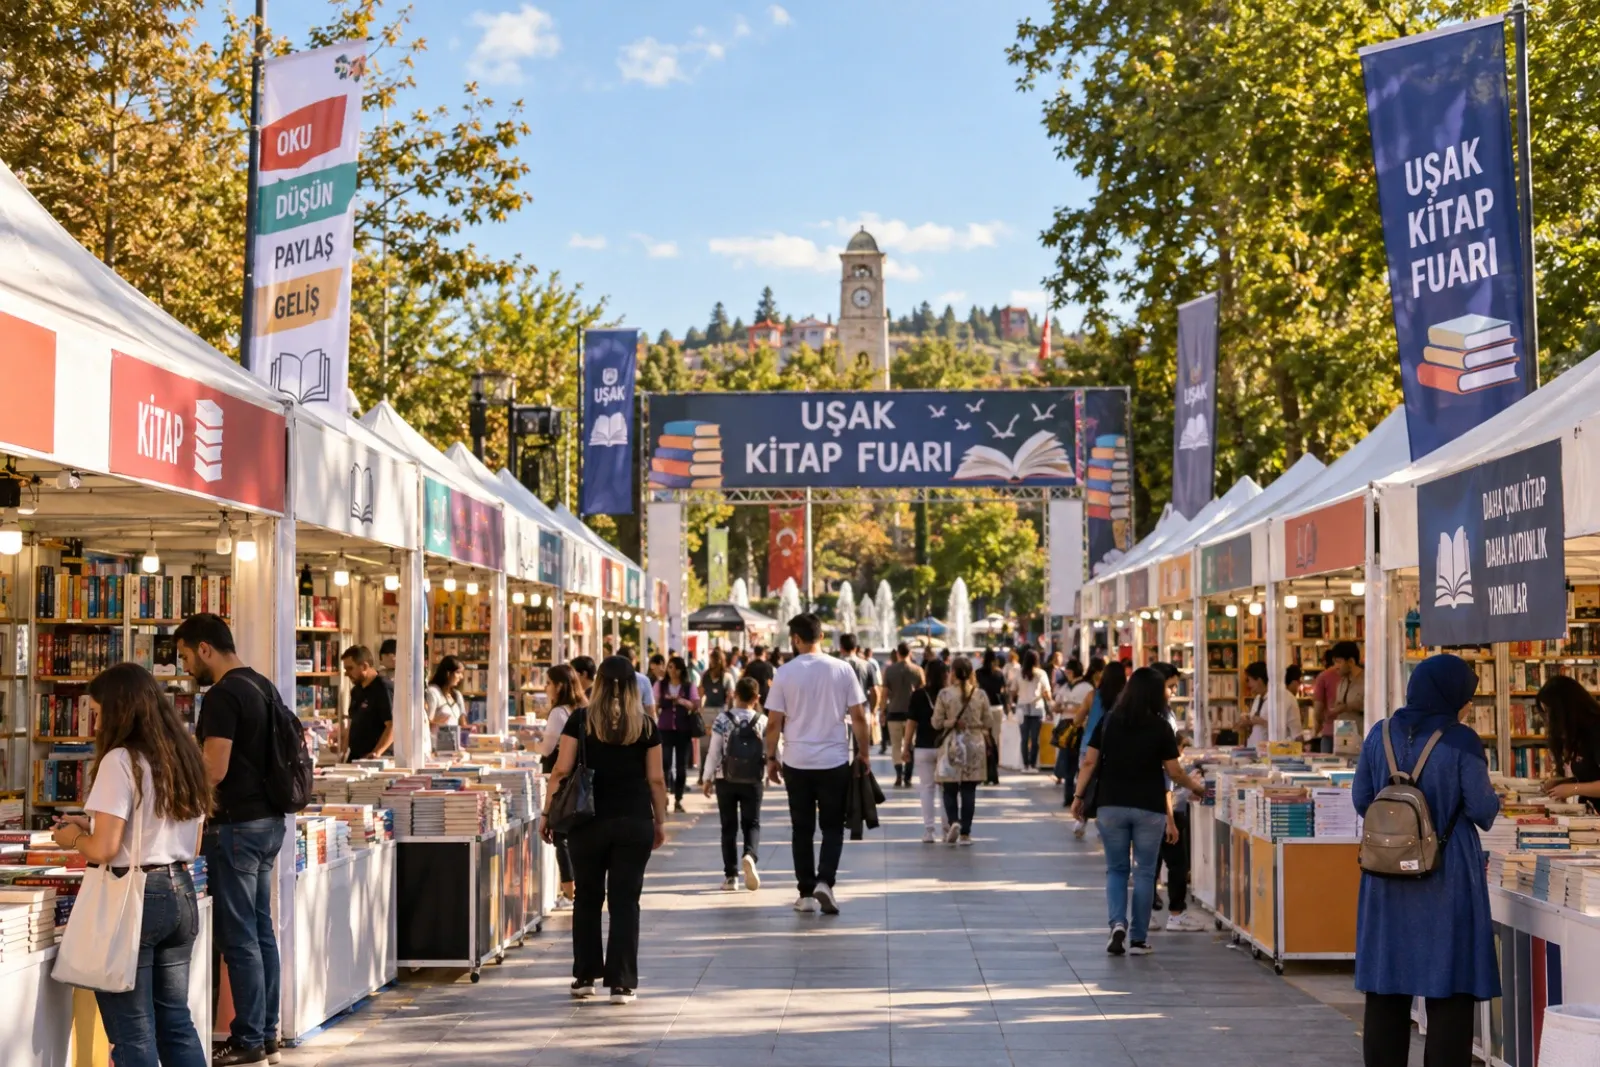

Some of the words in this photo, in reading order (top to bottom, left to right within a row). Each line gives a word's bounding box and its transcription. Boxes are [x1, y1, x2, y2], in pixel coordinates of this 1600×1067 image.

[277, 123, 312, 156] OKU
[1404, 136, 1483, 197] UŞAK
[275, 179, 334, 219] DÜŞÜN
[1407, 187, 1494, 248] KİTAP
[274, 232, 334, 269] PAYLAŞ
[1411, 237, 1499, 299] FUARI
[274, 284, 320, 319] GELİŞ
[594, 385, 625, 407] UŞAK
[137, 393, 184, 465] KİTAP
[801, 400, 896, 437] UŞAK
[745, 436, 843, 473] KİTAP
[858, 441, 952, 473] FUARI
[1482, 488, 1503, 521] DAHA
[1504, 482, 1521, 522] ÇOK
[1521, 473, 1547, 509] KİTAP
[1485, 536, 1507, 568] DAHA
[1508, 527, 1548, 565] AYDINLIK
[1488, 582, 1528, 616] YARINLAR
